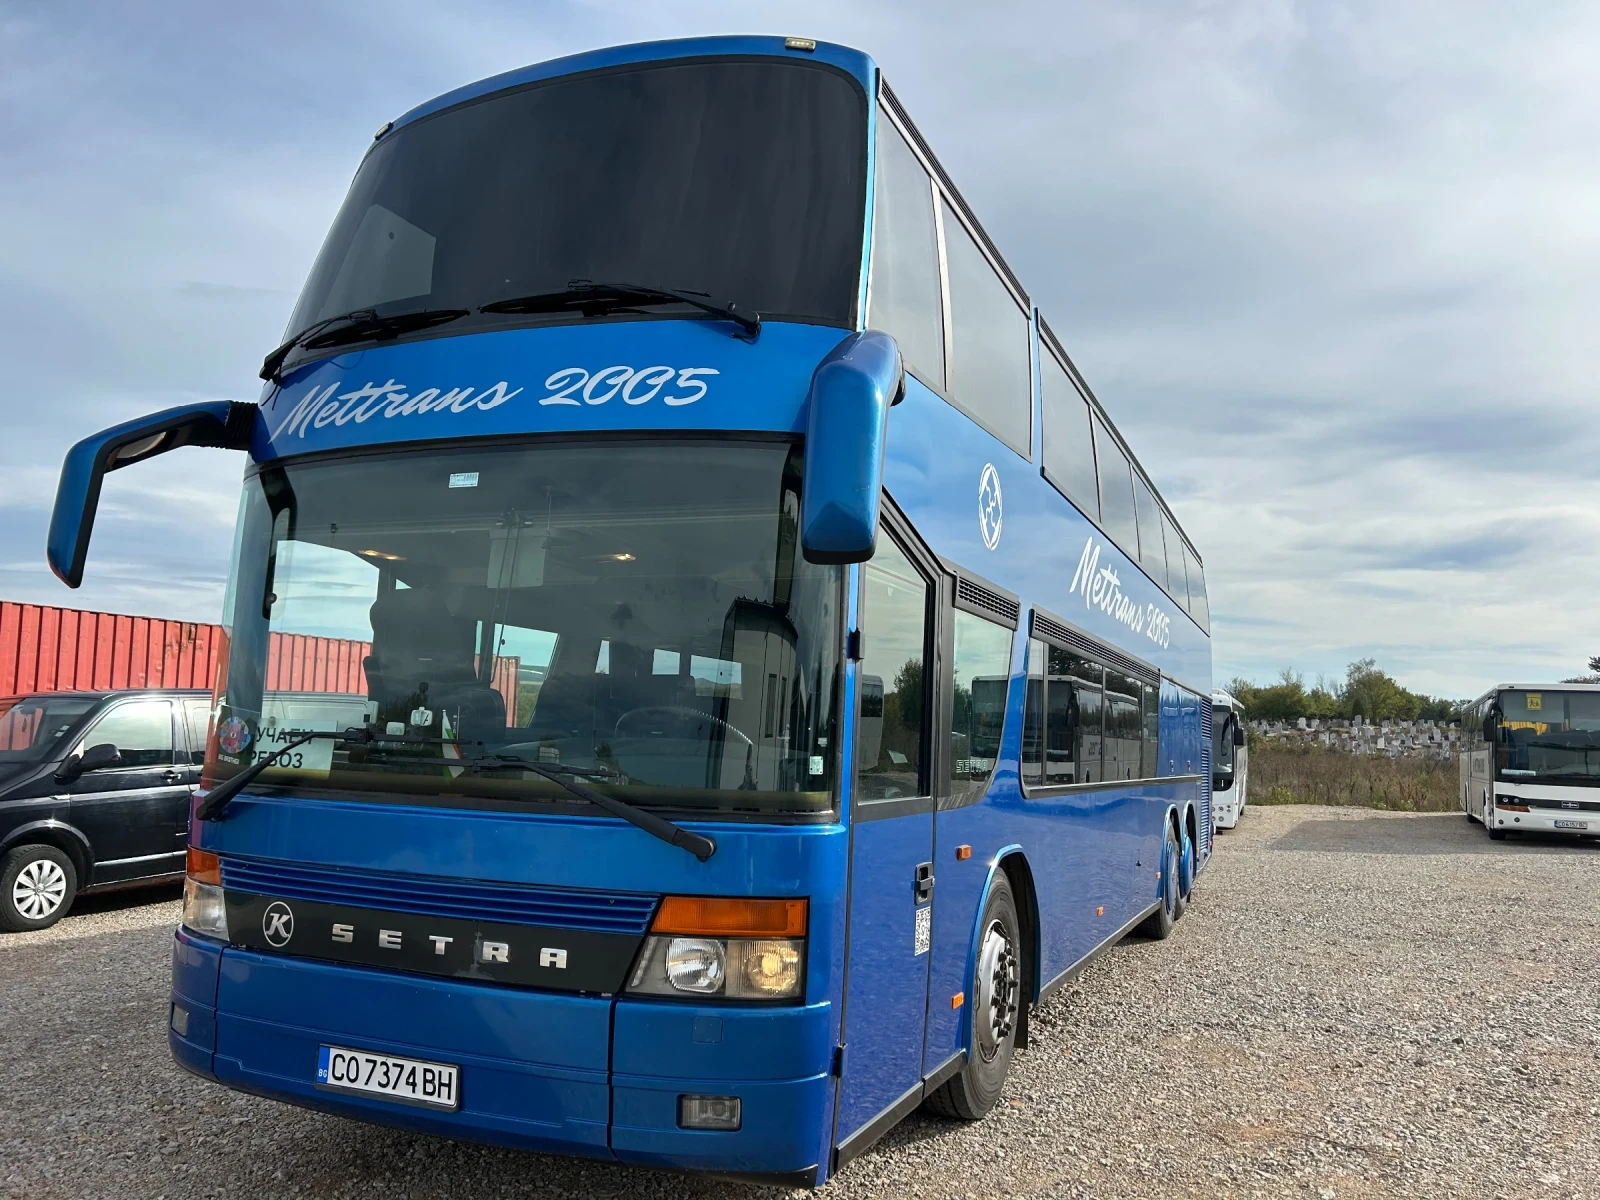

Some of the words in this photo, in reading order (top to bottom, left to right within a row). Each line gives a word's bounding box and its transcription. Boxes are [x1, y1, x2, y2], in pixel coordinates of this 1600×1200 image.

[267, 379, 525, 445] Mettrans
[538, 365, 721, 407] 2005
[1069, 536, 1145, 633] Mettrans
[1146, 602, 1171, 650] 2005
[955, 759, 988, 773] SETRA
[331, 922, 568, 969] SETRA
[318, 1068, 328, 1078] BG
[364, 1058, 418, 1094] 7374
